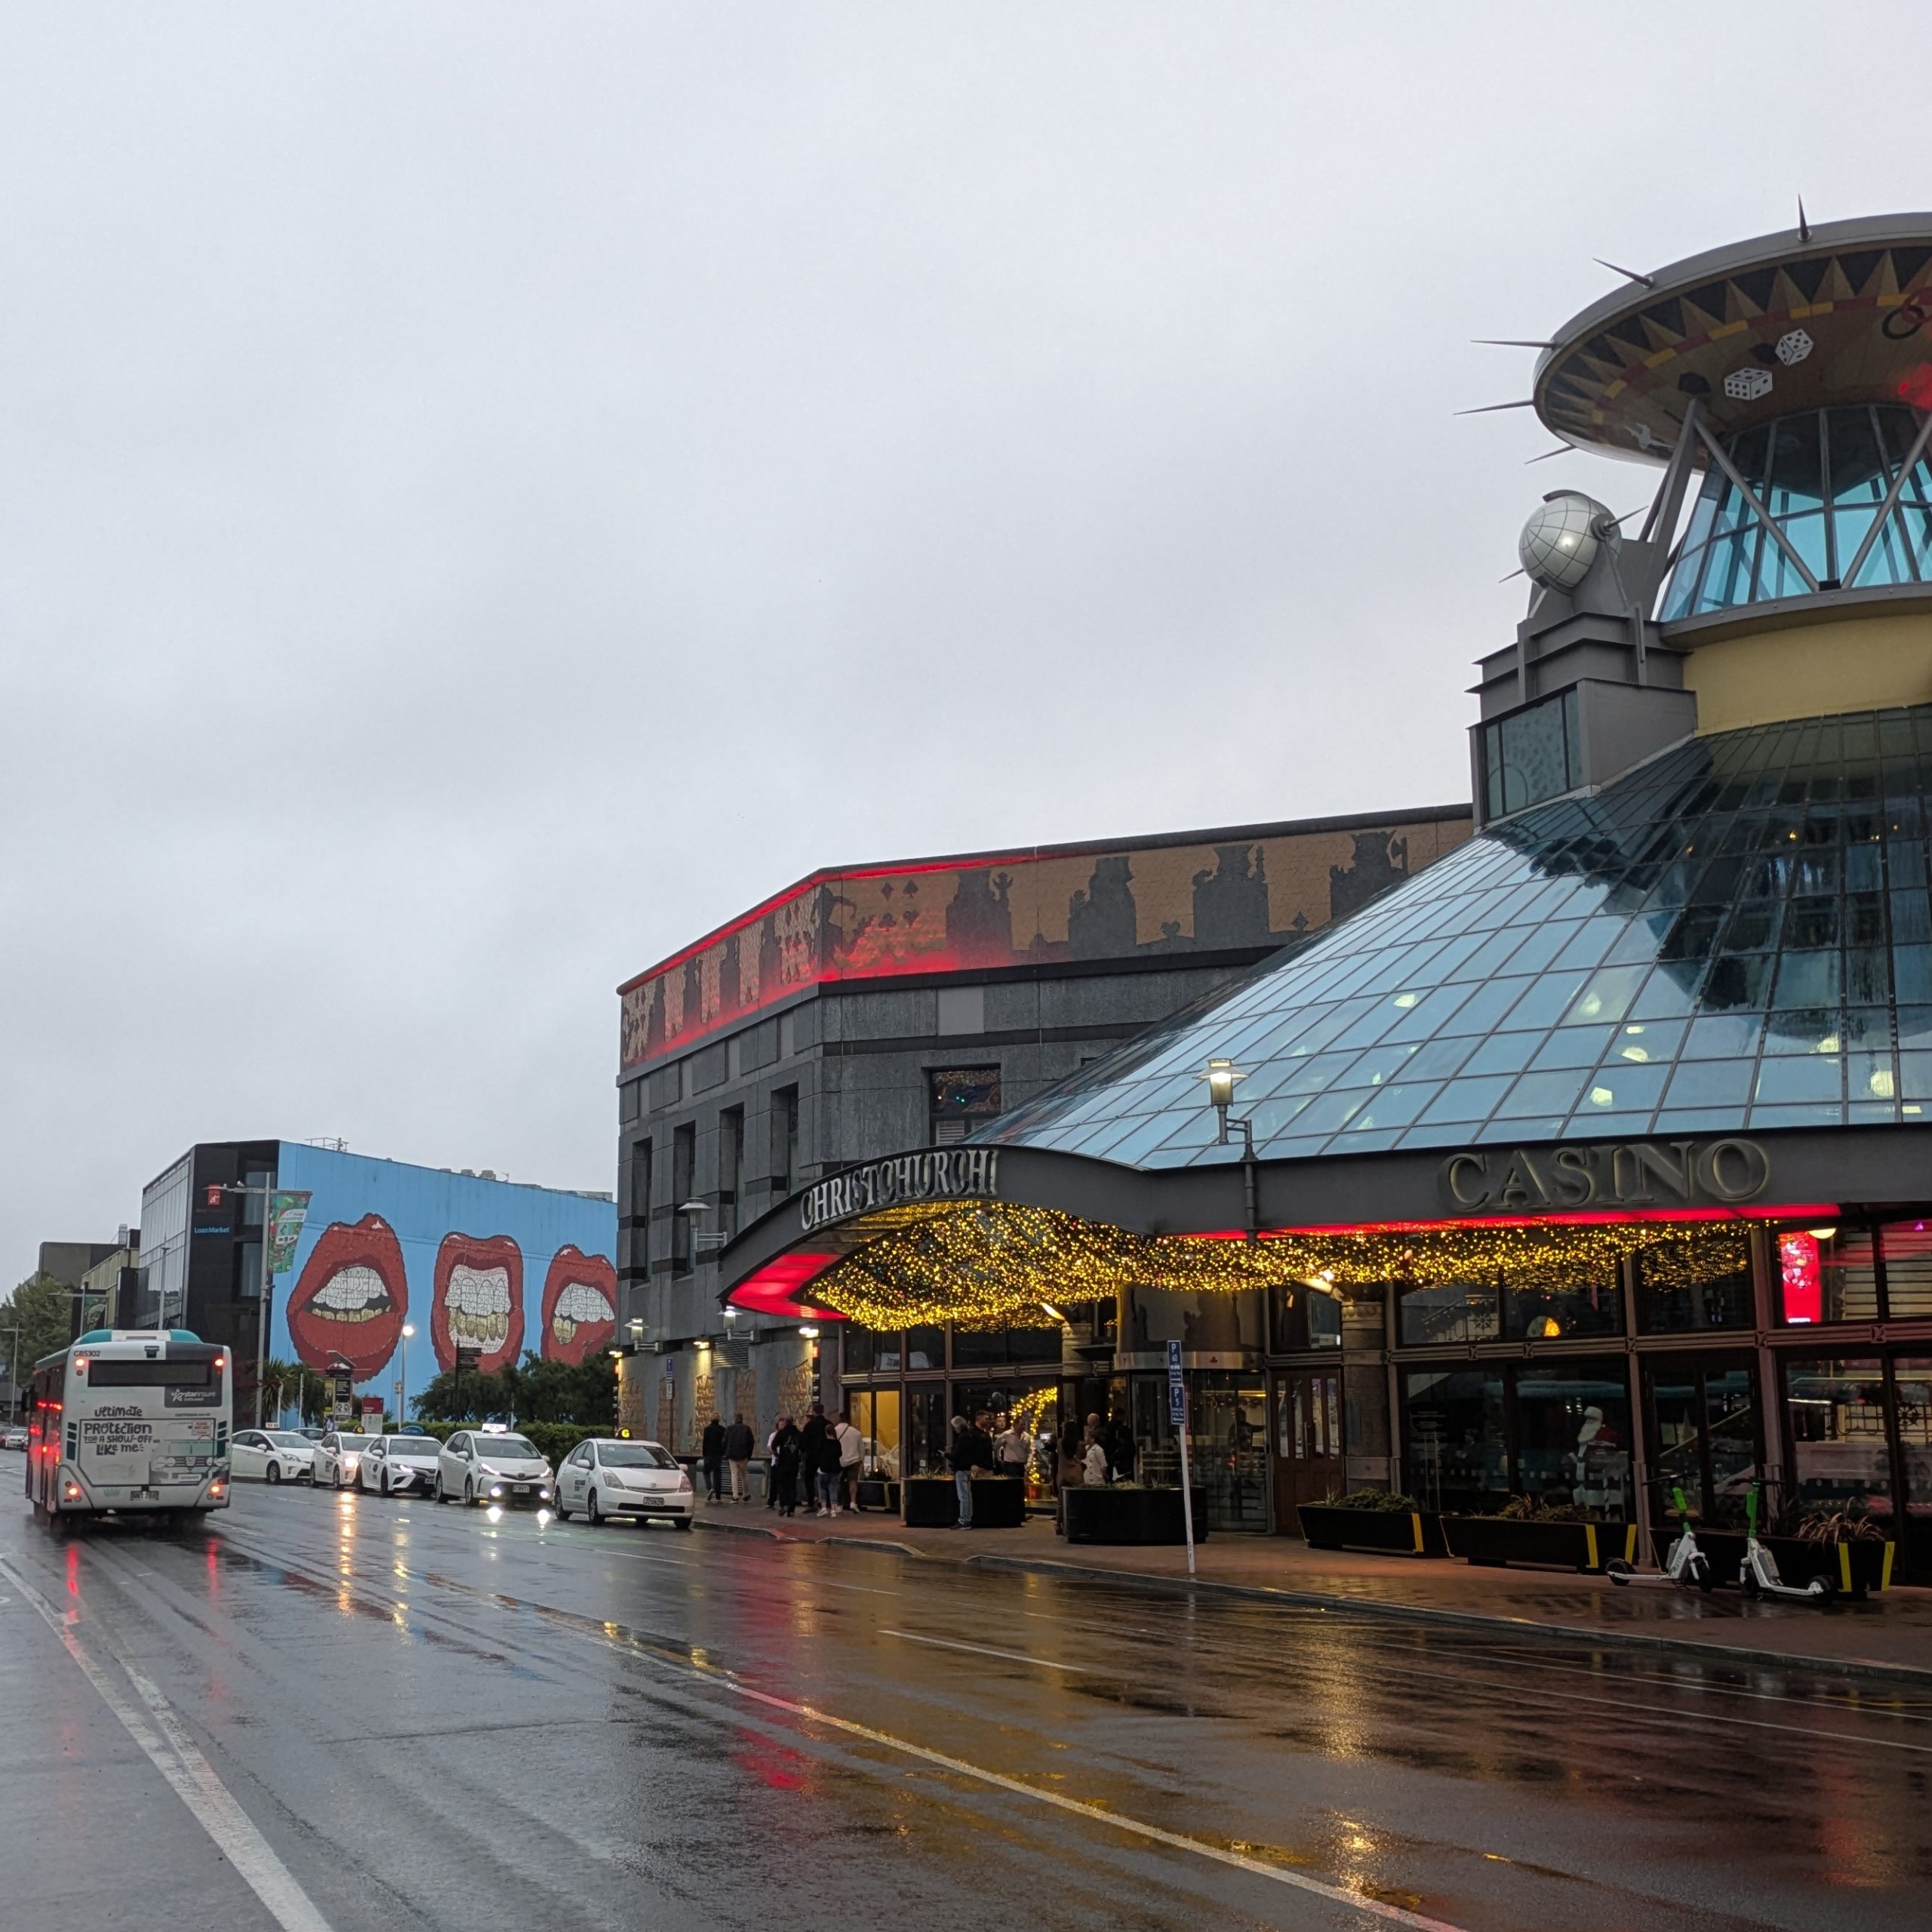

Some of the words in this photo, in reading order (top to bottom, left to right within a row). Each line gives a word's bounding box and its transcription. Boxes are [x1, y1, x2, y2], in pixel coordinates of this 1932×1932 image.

[801, 1149, 998, 1231] CHRISTCHURCH
[1438, 1139, 1770, 1209] CASINO
[106, 1435, 153, 1444] SHOW-OFF
[621, 1429, 630, 1438] G
